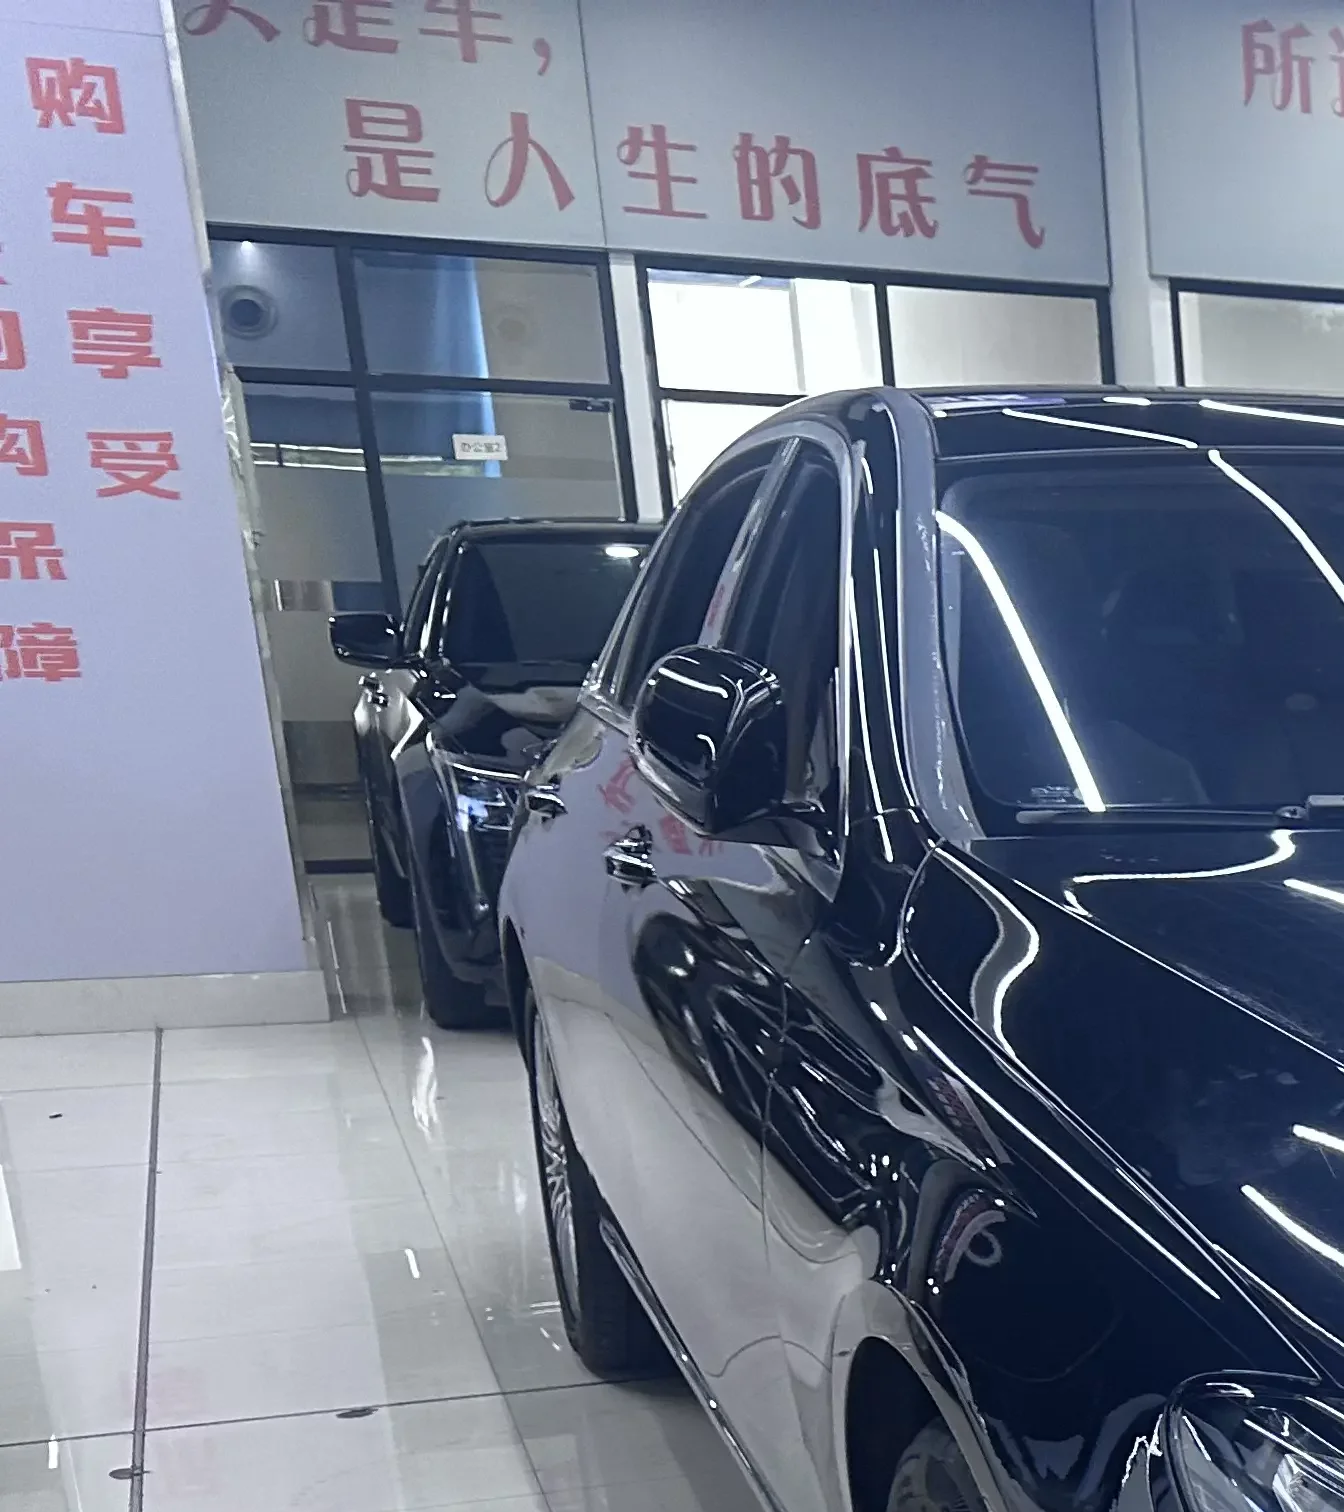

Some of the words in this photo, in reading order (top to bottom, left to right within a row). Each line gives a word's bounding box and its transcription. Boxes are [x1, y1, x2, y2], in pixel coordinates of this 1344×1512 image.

[25, 57, 183, 501] 购车享受
[343, 97, 1046, 249] 是人生的底气
